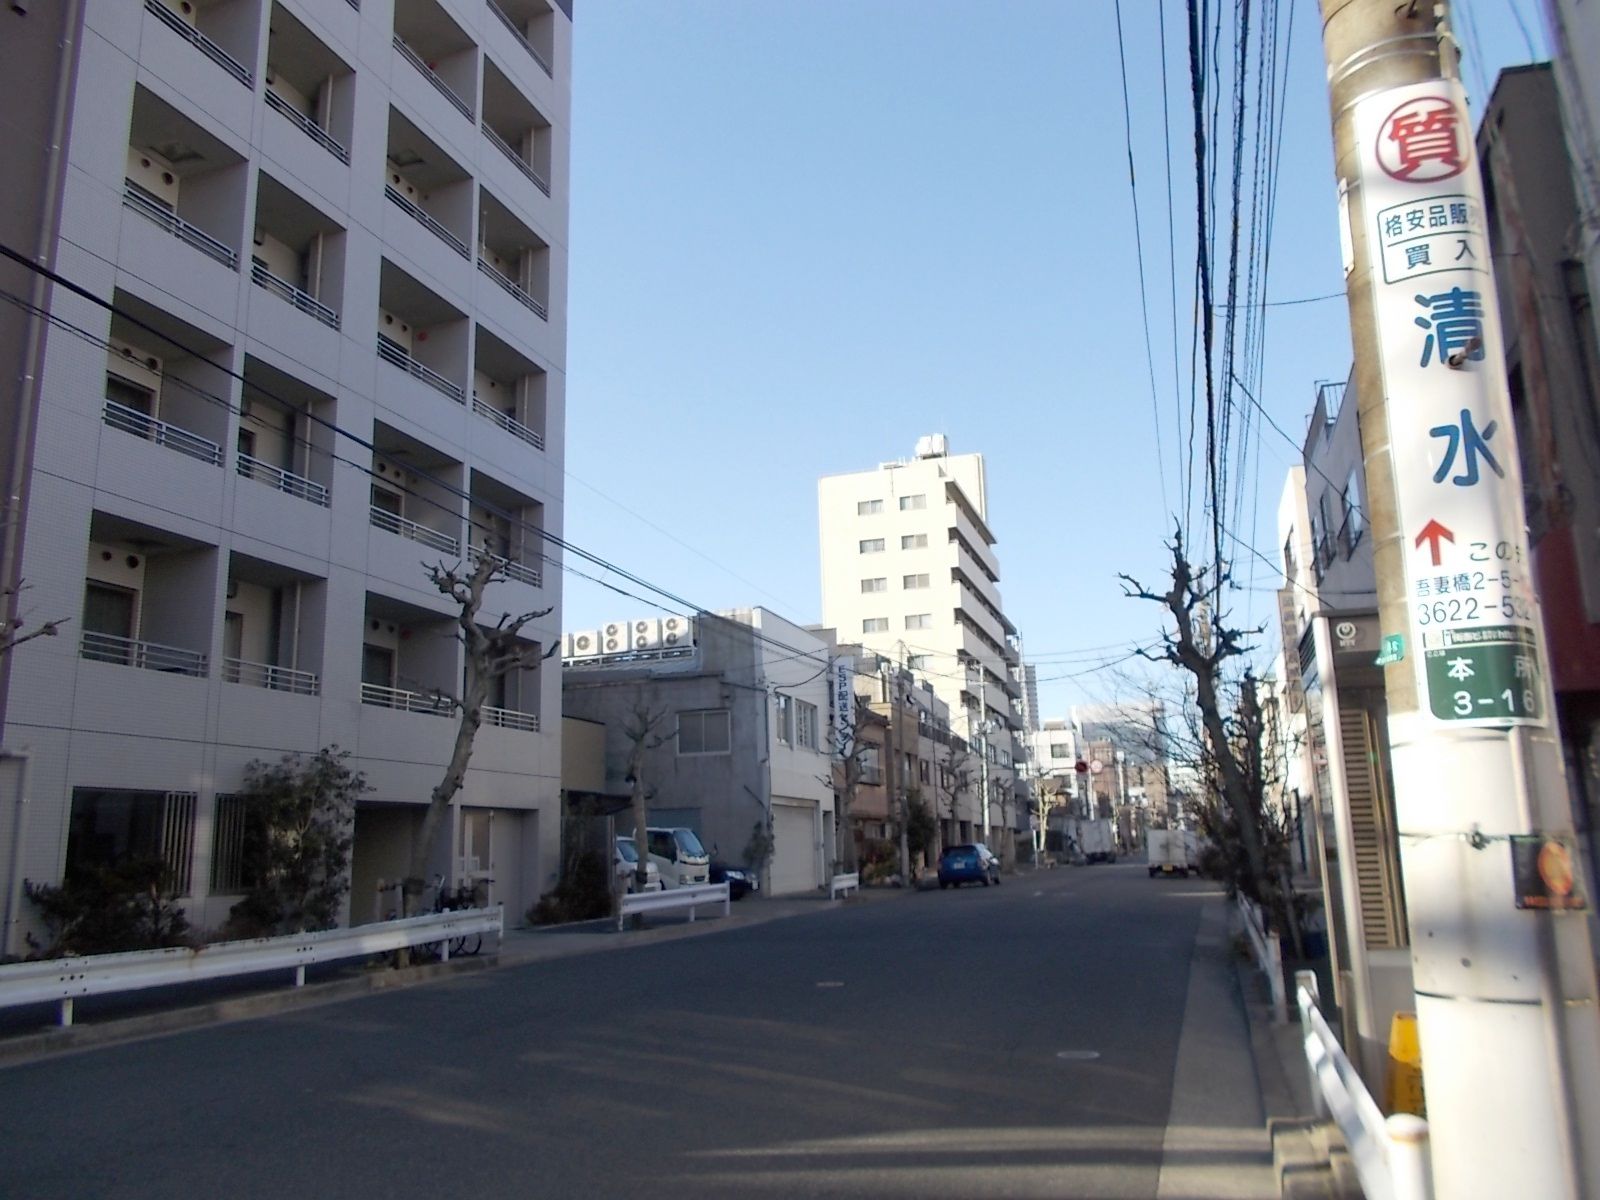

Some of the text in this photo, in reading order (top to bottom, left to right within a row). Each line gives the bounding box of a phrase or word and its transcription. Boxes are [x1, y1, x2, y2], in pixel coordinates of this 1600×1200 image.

[1388, 105, 1460, 177] 質
[1385, 203, 1480, 238] 格安品販
[1405, 240, 1477, 270] 買入
[1414, 286, 1505, 487] 清水
[1470, 541, 1521, 564] この
[1454, 689, 1535, 716] 3-16
